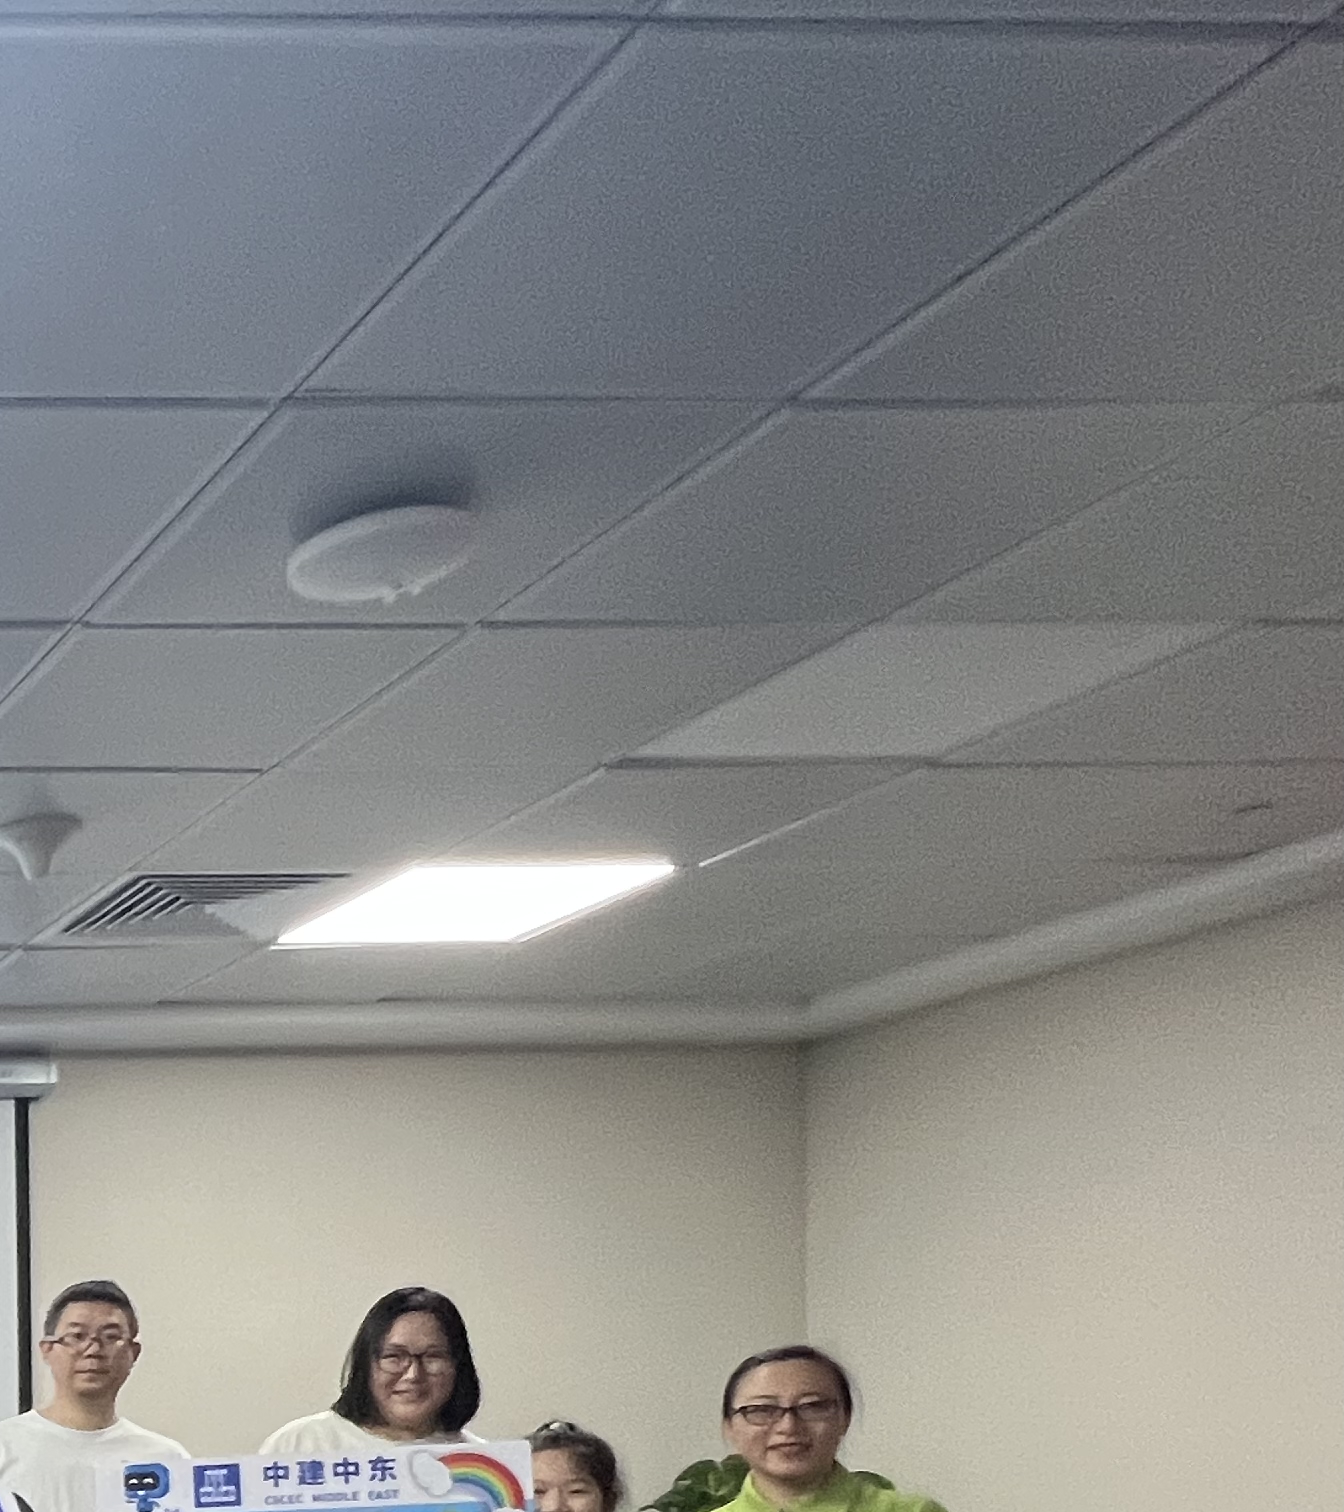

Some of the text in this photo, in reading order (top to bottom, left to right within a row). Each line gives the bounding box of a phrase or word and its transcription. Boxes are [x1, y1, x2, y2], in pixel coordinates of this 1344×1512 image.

[263, 1456, 397, 1487] 中建中东
[264, 1488, 400, 1506] CSCEC MIDDLE EAST
